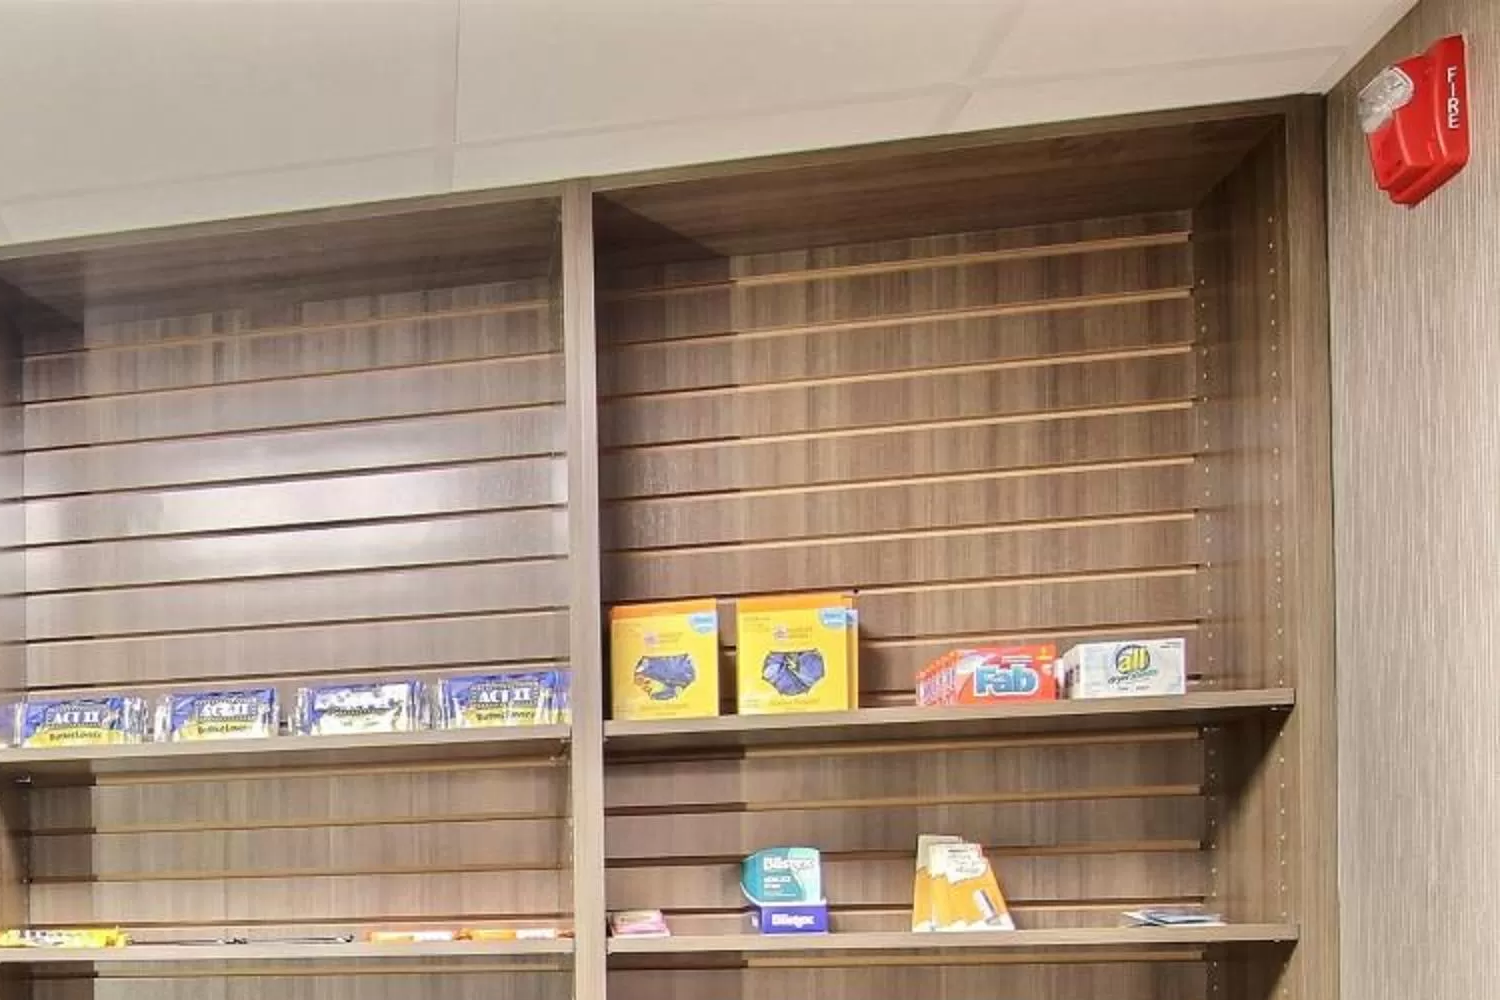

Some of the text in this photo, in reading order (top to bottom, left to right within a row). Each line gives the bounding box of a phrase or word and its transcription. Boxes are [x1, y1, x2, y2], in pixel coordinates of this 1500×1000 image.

[1447, 66, 1460, 129] FIRE
[1118, 647, 1147, 673] all
[973, 663, 1042, 697] Fab
